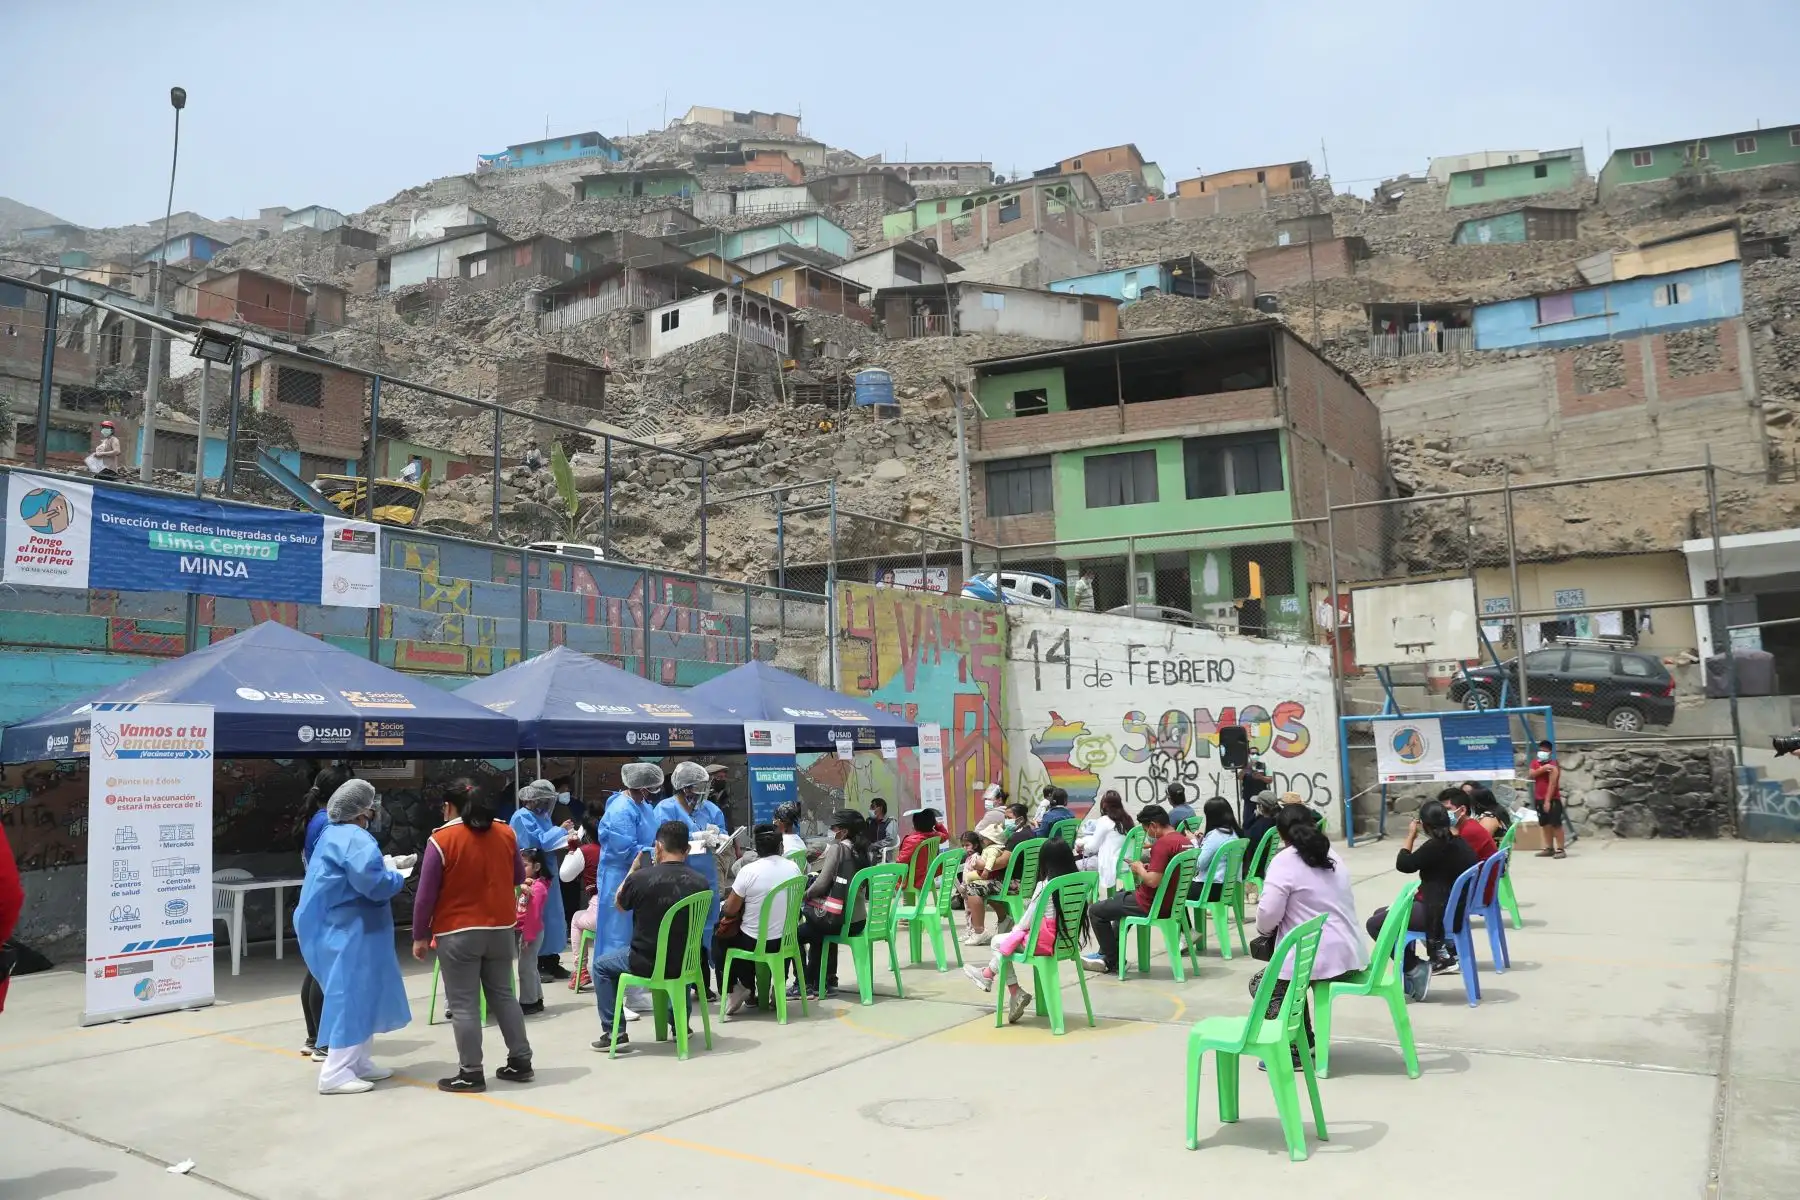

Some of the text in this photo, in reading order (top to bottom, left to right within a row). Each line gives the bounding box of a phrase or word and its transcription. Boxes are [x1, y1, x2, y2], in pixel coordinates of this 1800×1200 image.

[101, 512, 317, 545] Dirección de Redes Integradas de Salud
[29, 535, 62, 548] Pongo
[157, 532, 271, 558] Lima Centro
[18, 544, 72, 556] el hombro
[15, 555, 74, 566] por el Perú
[180, 556, 248, 578] MINSA
[1026, 628, 1235, 692] 14 de FEBRERO
[120, 723, 207, 738] Vamos a tu
[380, 722, 404, 730] Socios
[315, 727, 352, 737] USAID
[637, 732, 660, 740] USAID
[1119, 700, 1311, 764] SOMOS
[122, 738, 205, 749] encuentro
[1116, 774, 1200, 806] TODS
[1272, 771, 1333, 807] DOS
[117, 793, 196, 803] Ahora la vacunación
[117, 802, 143, 811] estará
[184, 800, 193, 808] de
[114, 880, 142, 889] Centros
[166, 877, 191, 885] Centros
[111, 888, 140, 897] de salud
[157, 883, 196, 893] comerciales
[165, 917, 192, 926] Estadios
[113, 923, 142, 932] Parques
